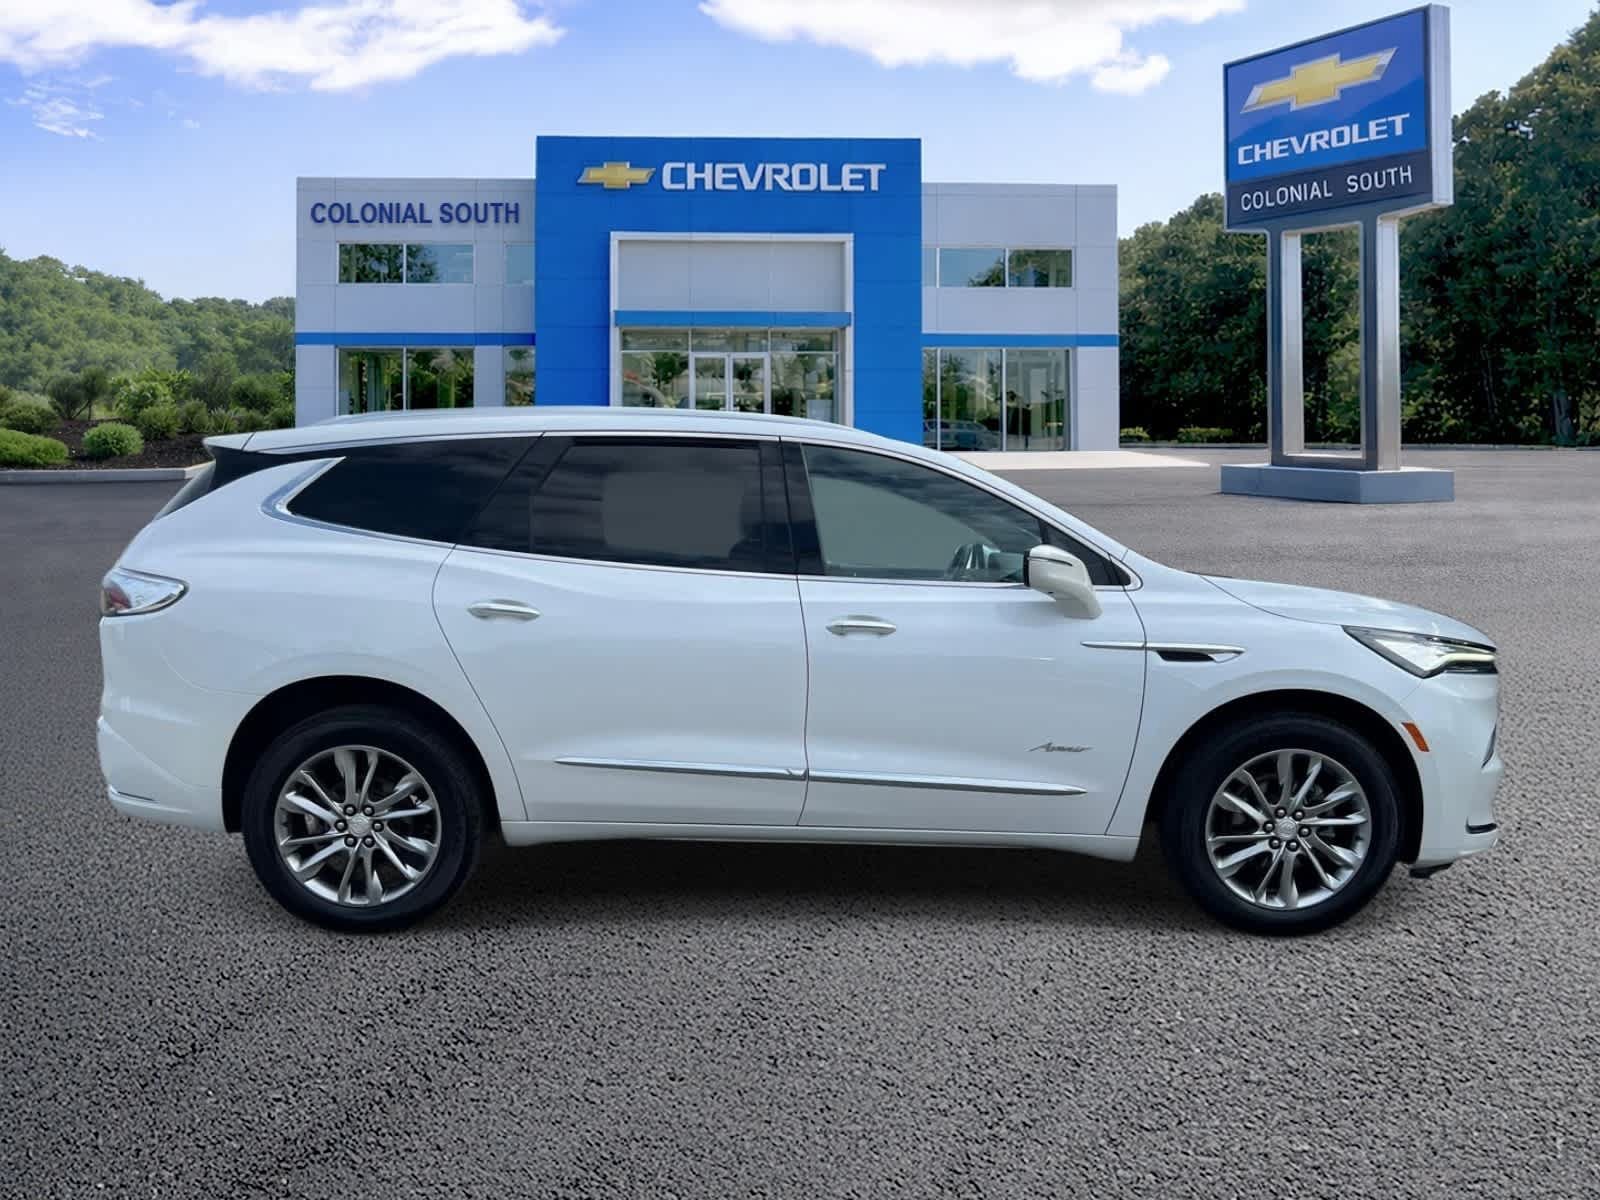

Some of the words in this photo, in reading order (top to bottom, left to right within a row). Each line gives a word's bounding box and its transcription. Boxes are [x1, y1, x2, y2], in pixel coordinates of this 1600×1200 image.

[1238, 112, 1410, 165] CHEVROLET
[662, 162, 886, 192] CHEVROLET
[1241, 180, 1333, 211] COLONIAL
[1347, 165, 1413, 193] SOUTH
[310, 202, 433, 225] COLONIAL
[439, 202, 521, 225] SOUTH
